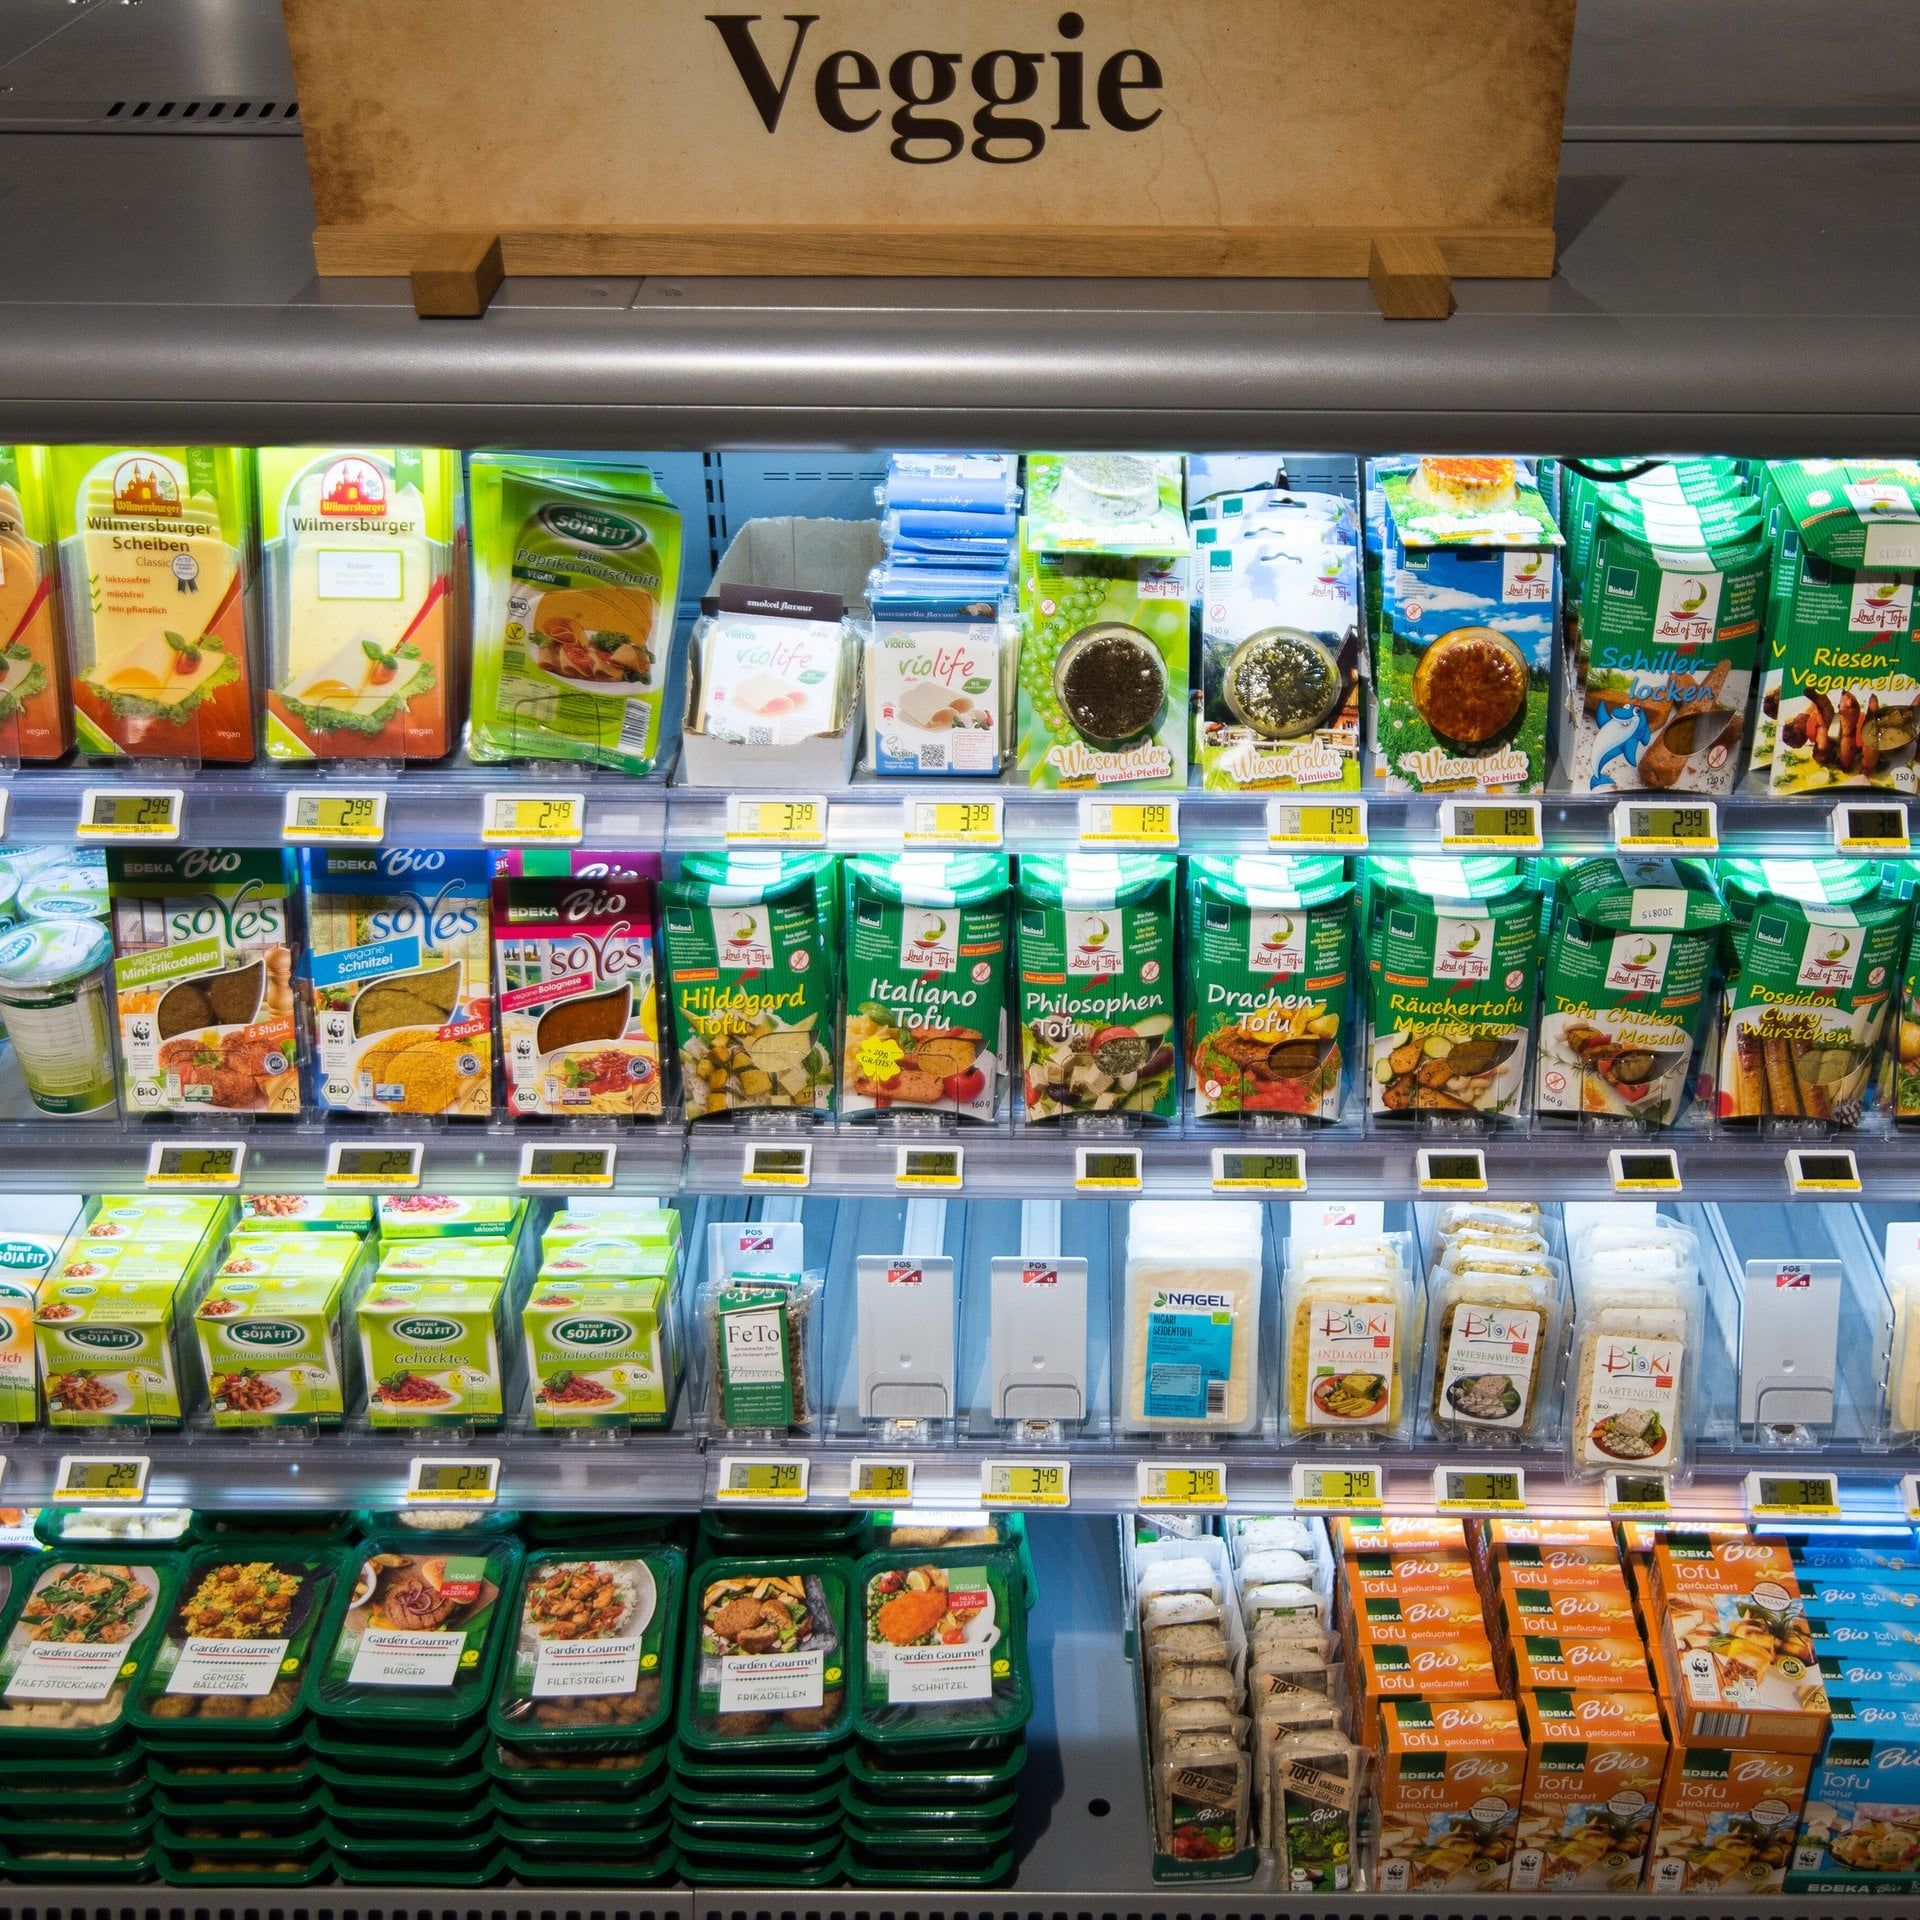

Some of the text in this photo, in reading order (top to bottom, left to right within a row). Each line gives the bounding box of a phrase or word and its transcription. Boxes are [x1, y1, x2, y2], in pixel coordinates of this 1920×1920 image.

[705, 12, 1163, 164] Veggie
[114, 500, 182, 516] Wilmersburger
[323, 500, 387, 516] Wilmersburger
[87, 516, 212, 536] Wilmersburger
[292, 517, 415, 536] Wilmersburger
[556, 516, 631, 542] SOJA FIT
[112, 536, 190, 552] Scheiben
[577, 549, 603, 562] Bio
[517, 549, 661, 589] Paprika-Aufschnitt
[526, 569, 556, 584] VEGAN
[105, 575, 151, 585] laktosefrei
[107, 589, 144, 599] milchfrei
[1504, 583, 1550, 599] Lord of Tofu
[1607, 585, 1634, 598] Bioland
[108, 605, 167, 616] rein pflanzlich
[747, 598, 814, 613] smoked flavour
[1656, 621, 1679, 637] Lord
[1680, 622, 1690, 640] of
[1691, 622, 1713, 640] Tofu
[884, 638, 916, 649] Viotros
[737, 643, 812, 677] violife
[1602, 646, 1716, 672] Schiller-
[1813, 646, 1900, 668] Riesen-
[899, 646, 975, 687] violife
[1629, 676, 1715, 701] locken
[1791, 668, 1919, 694] Vegarnelen
[26, 727, 50, 738] vegan
[217, 729, 241, 740] vegan
[1098, 766, 1170, 783] Urwald-Pfeffer
[1297, 768, 1342, 783] Almliebe
[1482, 771, 1527, 784] Der Hirte
[1895, 772, 1916, 783] 150 g
[124, 846, 242, 879] EDEKA Bio
[327, 859, 378, 871] EDEKA
[508, 889, 627, 922] EDEKA Bio
[1758, 932, 1783, 945] Bioland
[131, 949, 174, 966] vegane
[343, 946, 385, 962] vegane
[903, 949, 955, 968] Lord of Tofu
[121, 949, 219, 982] Mini-Frikadellen
[338, 955, 393, 974] Schnitzel
[512, 976, 582, 1001] vegane Bolognese
[869, 976, 977, 1007] Italiano
[1749, 984, 1839, 1007] Poseidon
[682, 983, 806, 1015] Hildegard
[1026, 990, 1164, 1021] Philosophen
[1207, 983, 1327, 1012] Drachen-
[1390, 994, 1523, 1019] Räuchertofu
[1554, 995, 1684, 1025] Tofu Chicken
[693, 1013, 749, 1036] Tofu
[890, 1006, 952, 1032] Tofu
[1235, 1011, 1291, 1035] Tofu
[1761, 1007, 1833, 1028] Curry-
[258, 1020, 290, 1036] Stück
[444, 1021, 485, 1040] 2 Stück
[1034, 1019, 1087, 1038] Tofu
[1394, 1015, 1517, 1037] Mediterran
[1742, 1022, 1854, 1043] Würstchen
[1618, 1027, 1684, 1045] Masala
[971, 1100, 991, 1109] 160 g
[1542, 1093, 1563, 1106] 160 g
[745, 1229, 764, 1237] POS
[1028, 1261, 1048, 1270] POS
[1168, 1293, 1230, 1307] NAGEL
[1153, 1314, 1177, 1325] NIGARI
[406, 1325, 452, 1336] SOJA FIT
[566, 1327, 620, 1340] SOJA FIT
[728, 1324, 780, 1344] FeTo
[1152, 1325, 1193, 1337] SEIDENTOFU
[394, 1352, 470, 1365] Gehacktes
[588, 1349, 649, 1361] Gehacktes
[1317, 1349, 1389, 1360] INDIAGOLD
[1456, 1349, 1526, 1365] WIESENWEISS
[1599, 1386, 1670, 1400] GARTENGRÜN
[1669, 1540, 1775, 1562] EDEKA Bio
[1671, 1563, 1721, 1581] Tofu
[1676, 1581, 1738, 1593] geräuchert
[368, 1633, 459, 1648] Garden Gourmet
[32, 1646, 122, 1661] Garden Gourmet
[545, 1643, 636, 1656] Garden Gourmet
[894, 1649, 985, 1662] Garden Gourmet
[202, 1671, 246, 1682] GEMÜSE
[382, 1665, 426, 1677] BURGER
[192, 1680, 249, 1690] BÄLLCHEN
[547, 1675, 626, 1687] FILET-STREIFEN
[912, 1681, 969, 1692] SCHNITZEL
[737, 1689, 807, 1702] FRIKADELLEN
[1398, 1708, 1485, 1729] EDEKA Bio
[1400, 1732, 1495, 1747] Tofu geräuchert
[1825, 1757, 1870, 1768] EDEKA
[1176, 1770, 1209, 1789] TOFU
[1288, 1762, 1321, 1784] TOFU
[1822, 1771, 1872, 1790] Tofu
[1318, 1780, 1346, 1796] KRÄUTER
[1310, 1808, 1339, 1823] Bio
[1807, 1883, 1870, 1893] EDEKA
